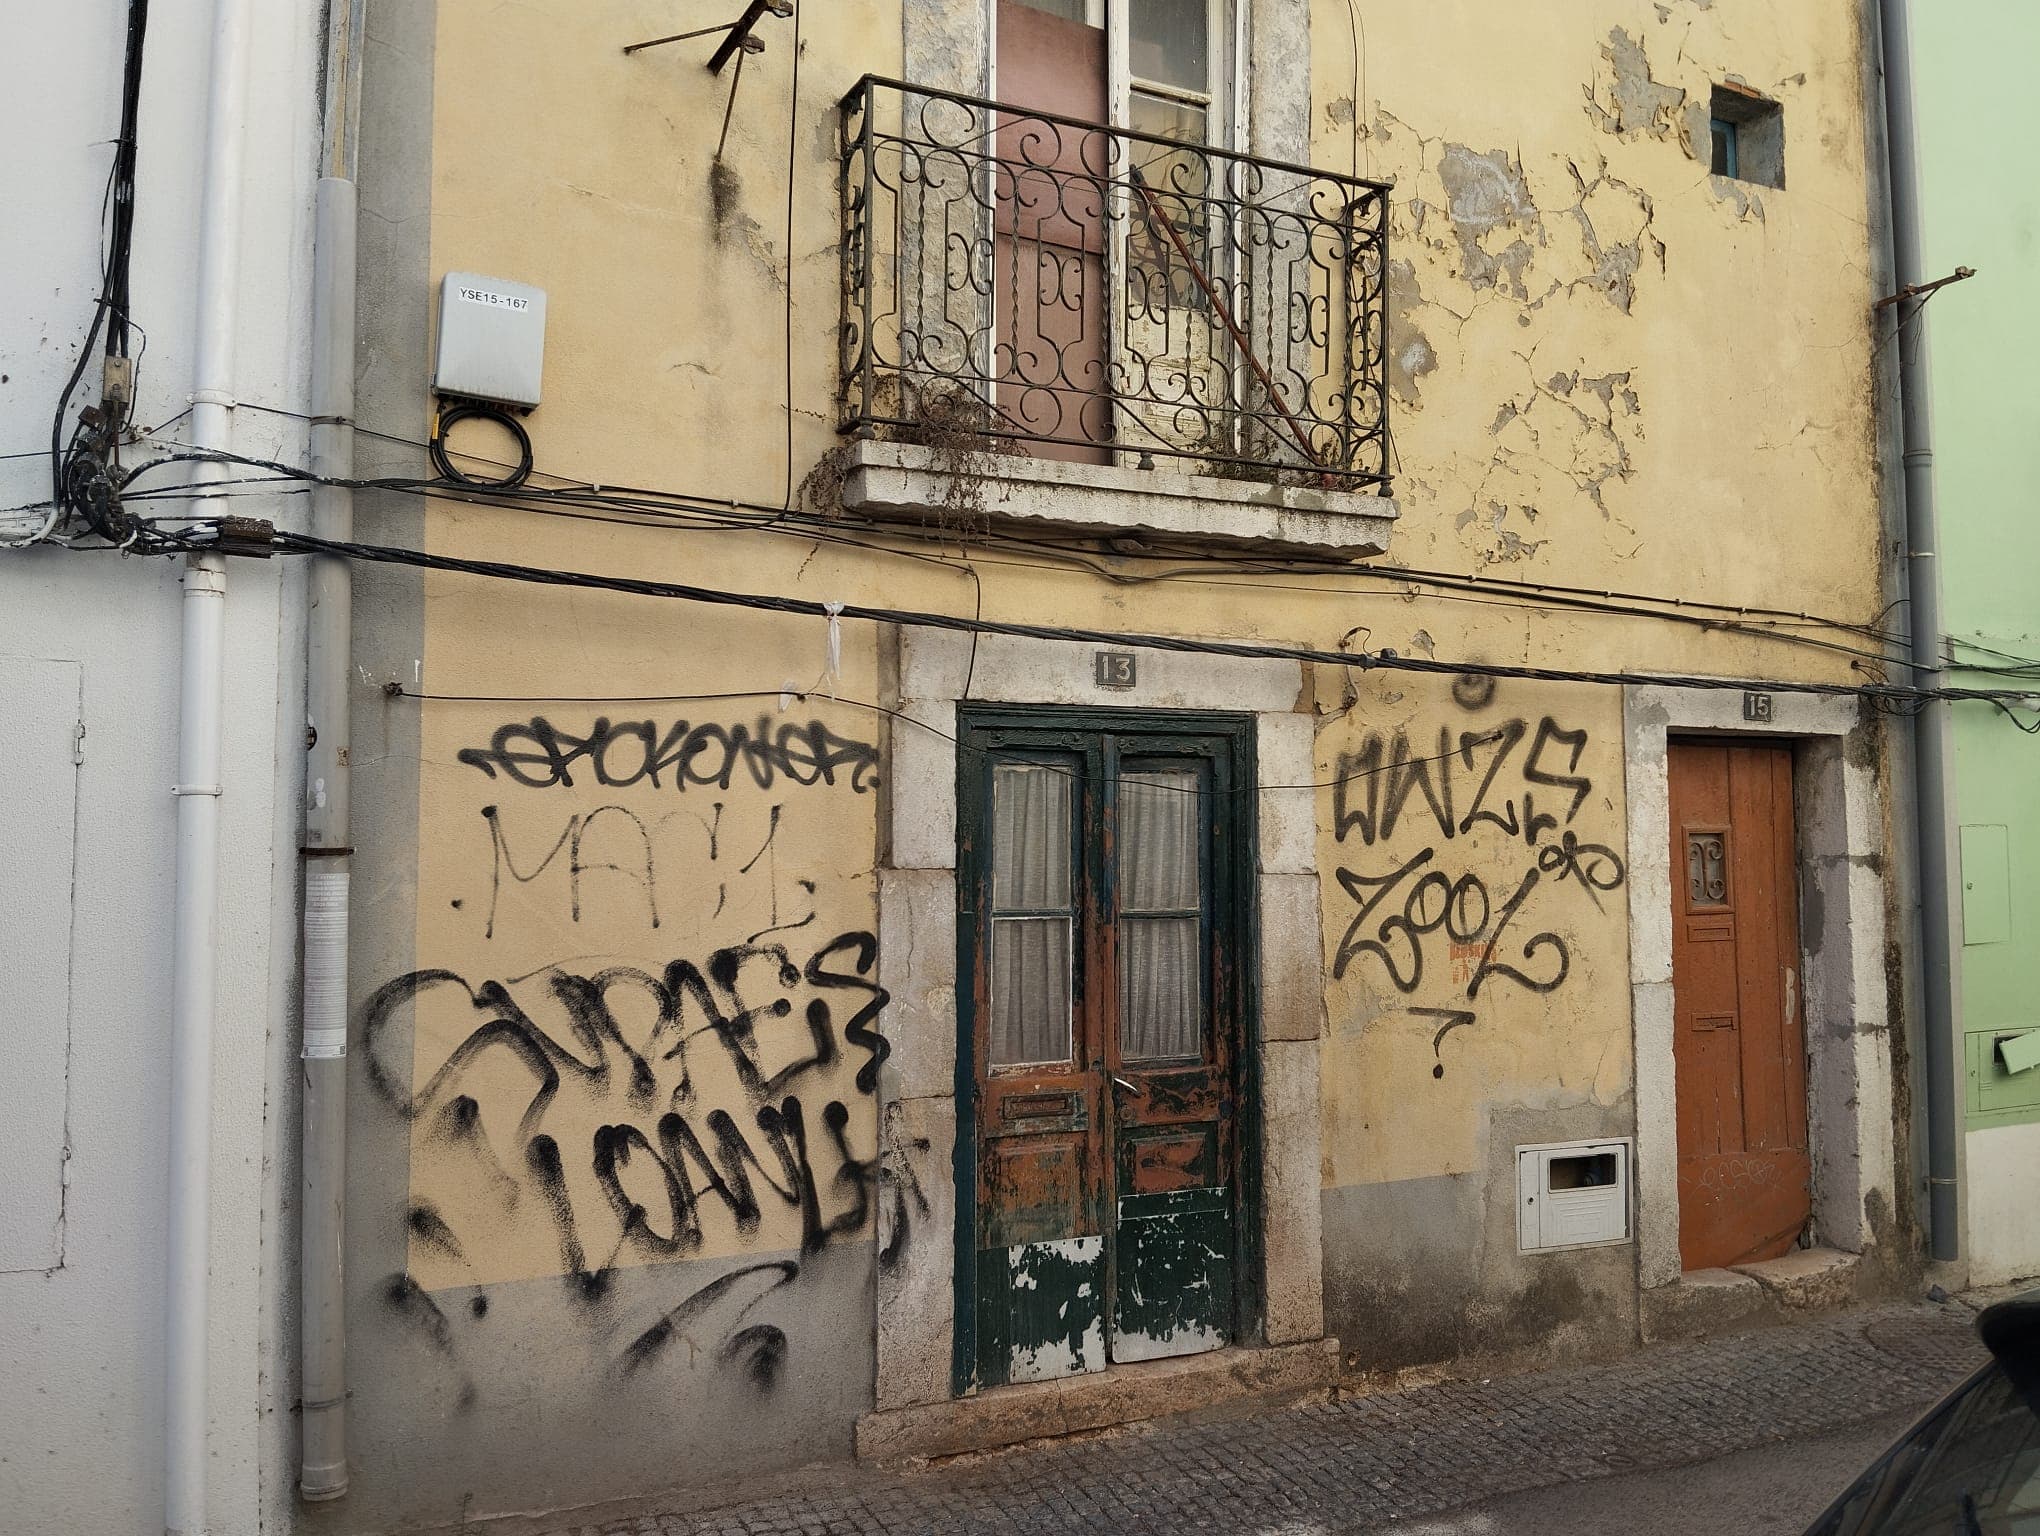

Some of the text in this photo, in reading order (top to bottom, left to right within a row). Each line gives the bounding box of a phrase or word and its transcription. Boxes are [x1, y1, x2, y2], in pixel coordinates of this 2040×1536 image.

[460, 287, 528, 309] YSE15-167
[1102, 655, 1131, 681] 13
[1750, 695, 1769, 716] 15
